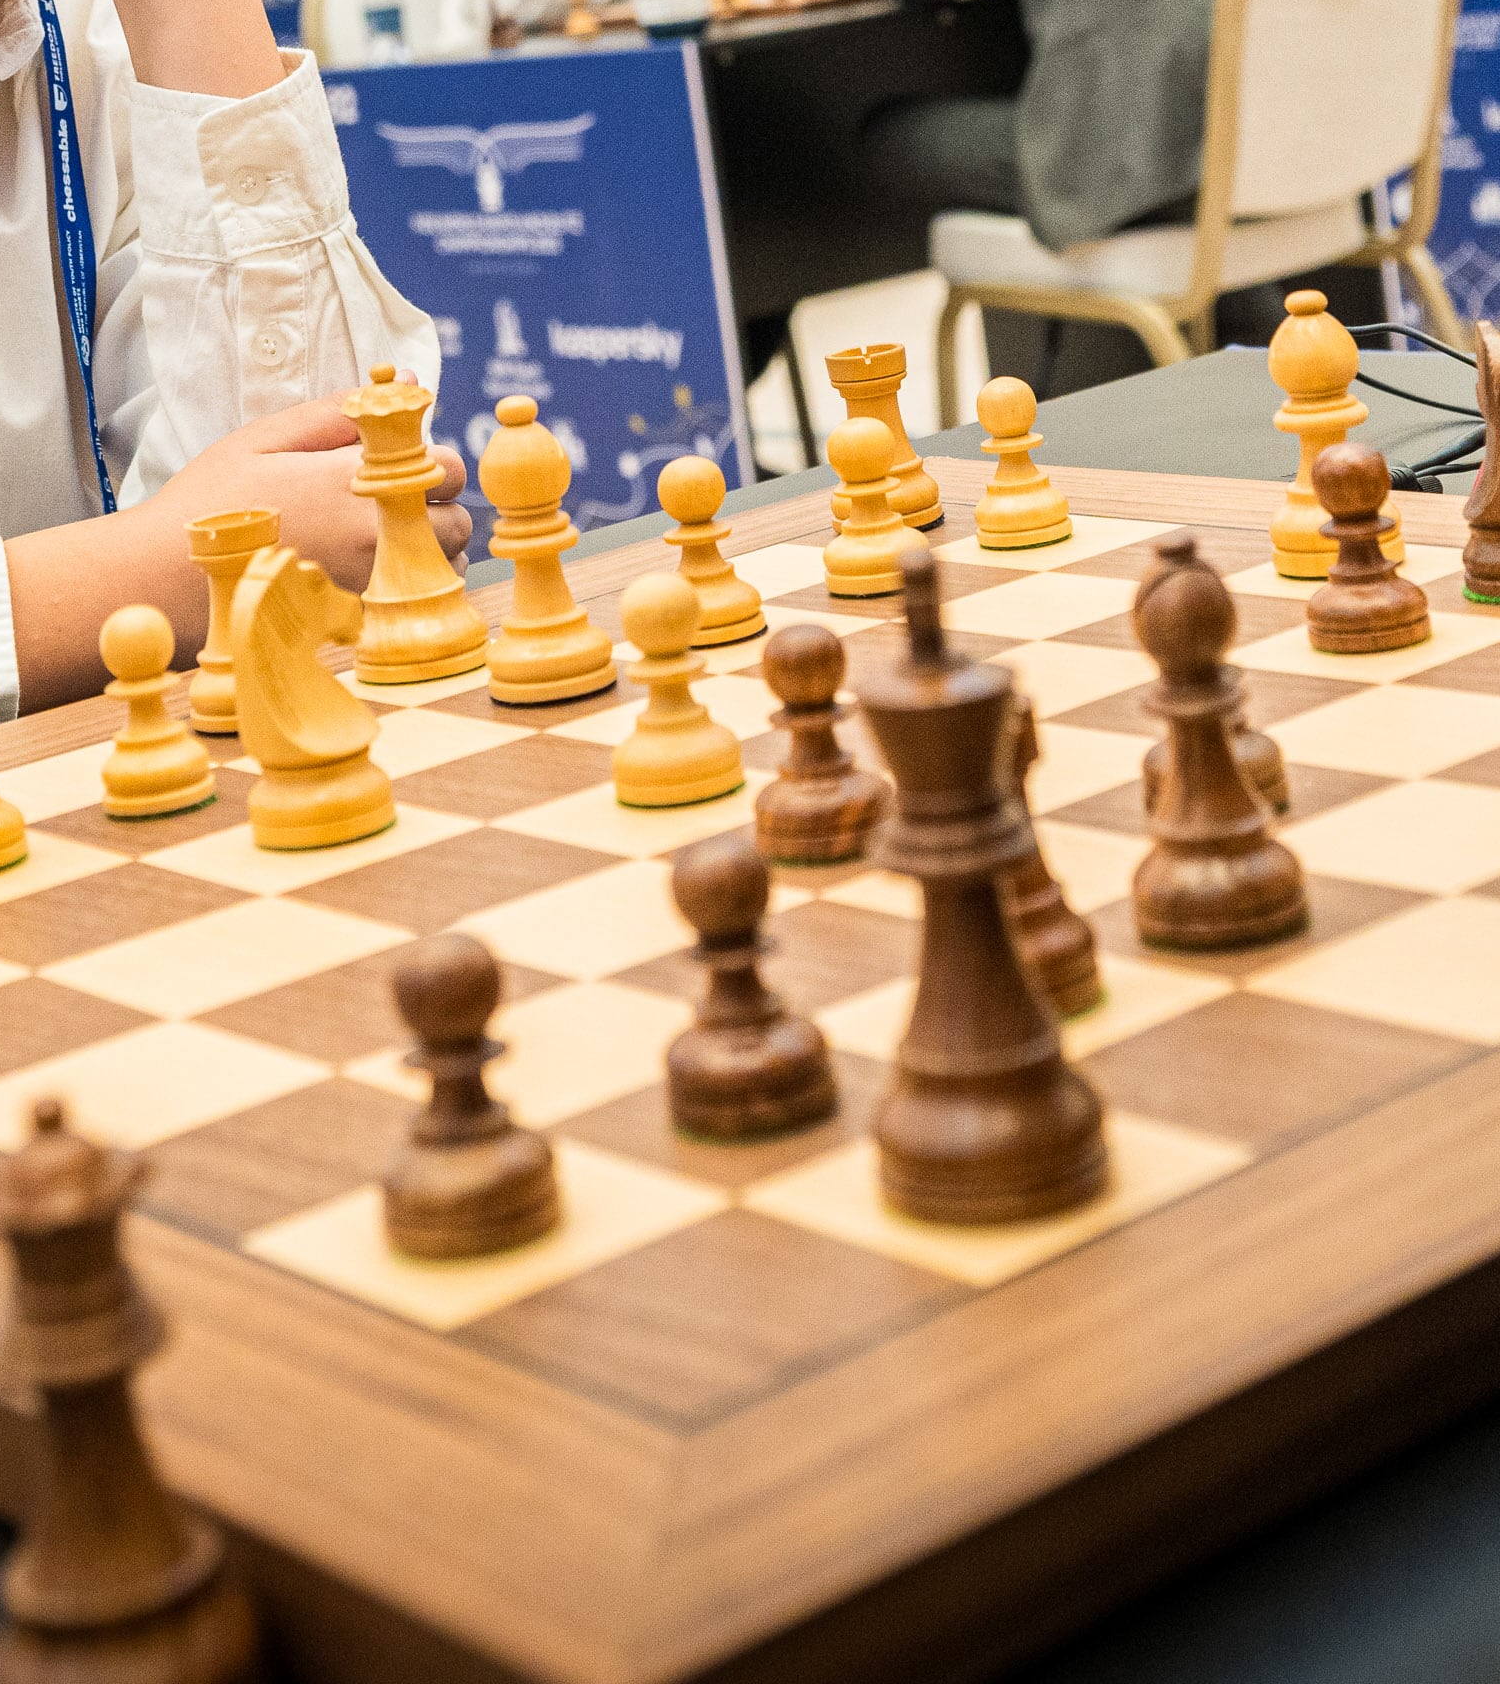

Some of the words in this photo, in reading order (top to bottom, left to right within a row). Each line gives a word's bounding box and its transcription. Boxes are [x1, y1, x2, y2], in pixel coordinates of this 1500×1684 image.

[46, 22, 60, 82] FREEDOM
[58, 118, 77, 222] chessable
[65, 229, 73, 257] POLICY
